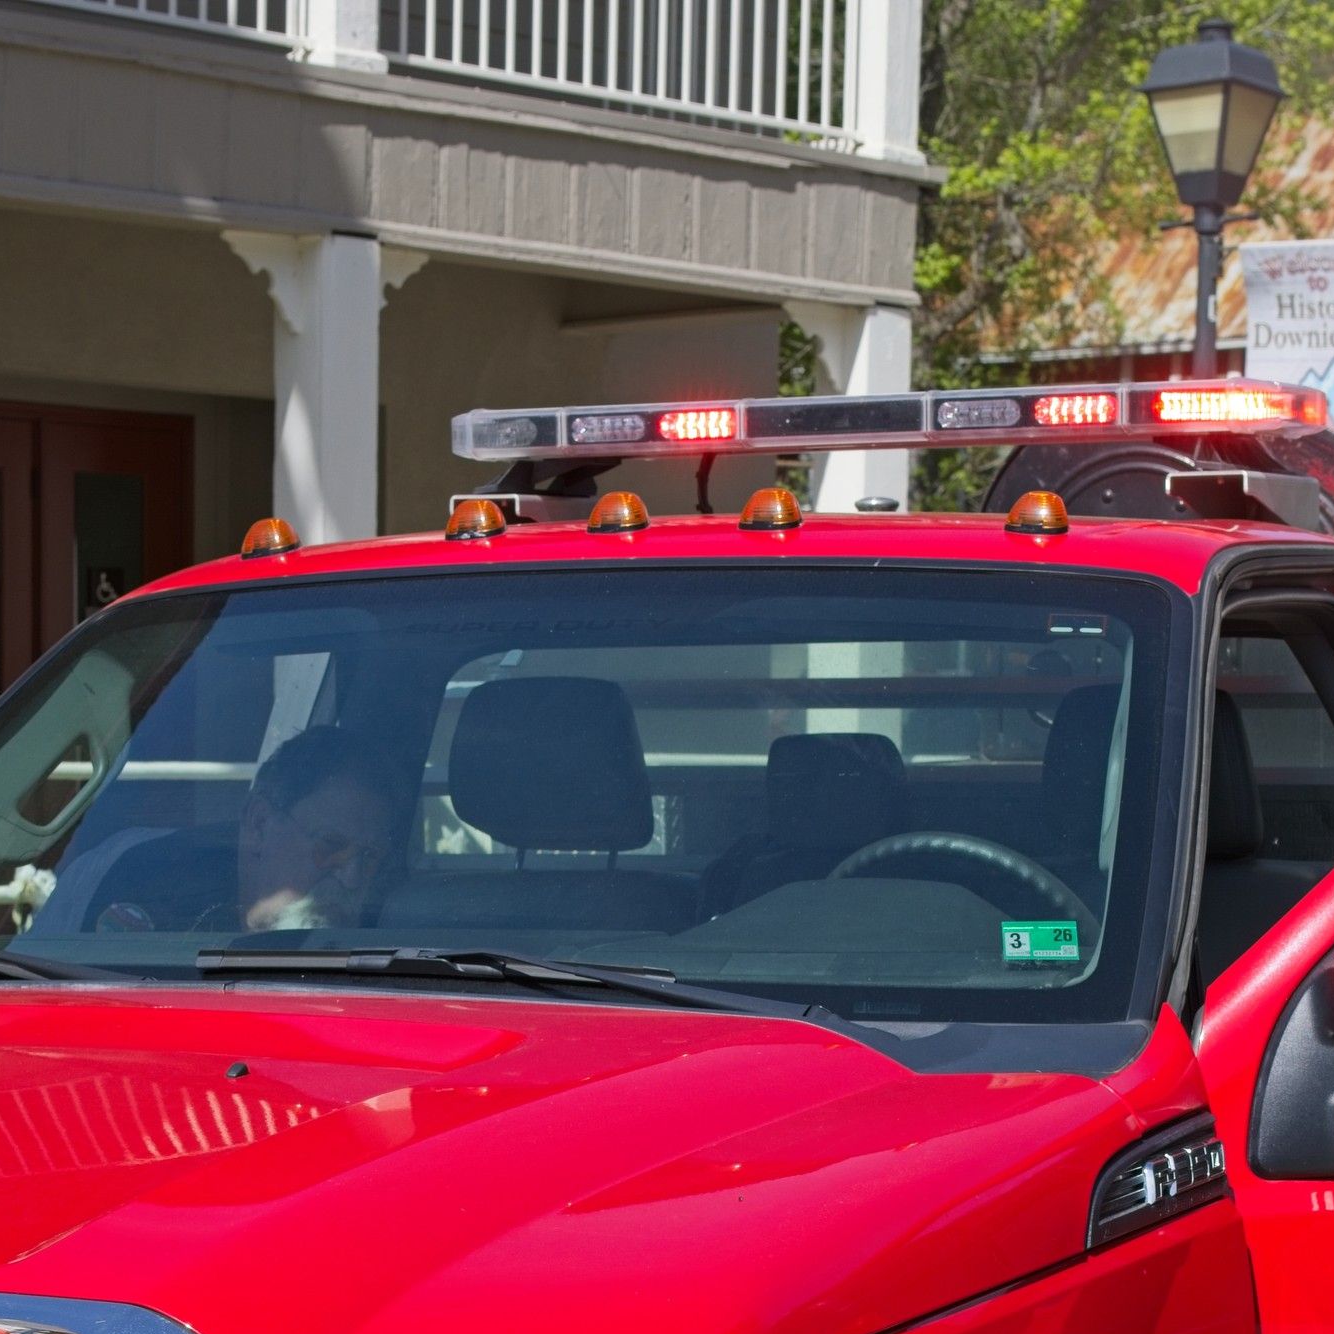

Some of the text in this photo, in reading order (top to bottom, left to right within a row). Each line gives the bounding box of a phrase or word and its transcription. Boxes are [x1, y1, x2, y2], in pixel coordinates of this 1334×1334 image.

[1307, 275, 1328, 292] to
[1010, 932, 1023, 949] 3
[1053, 928, 1073, 942] 26
